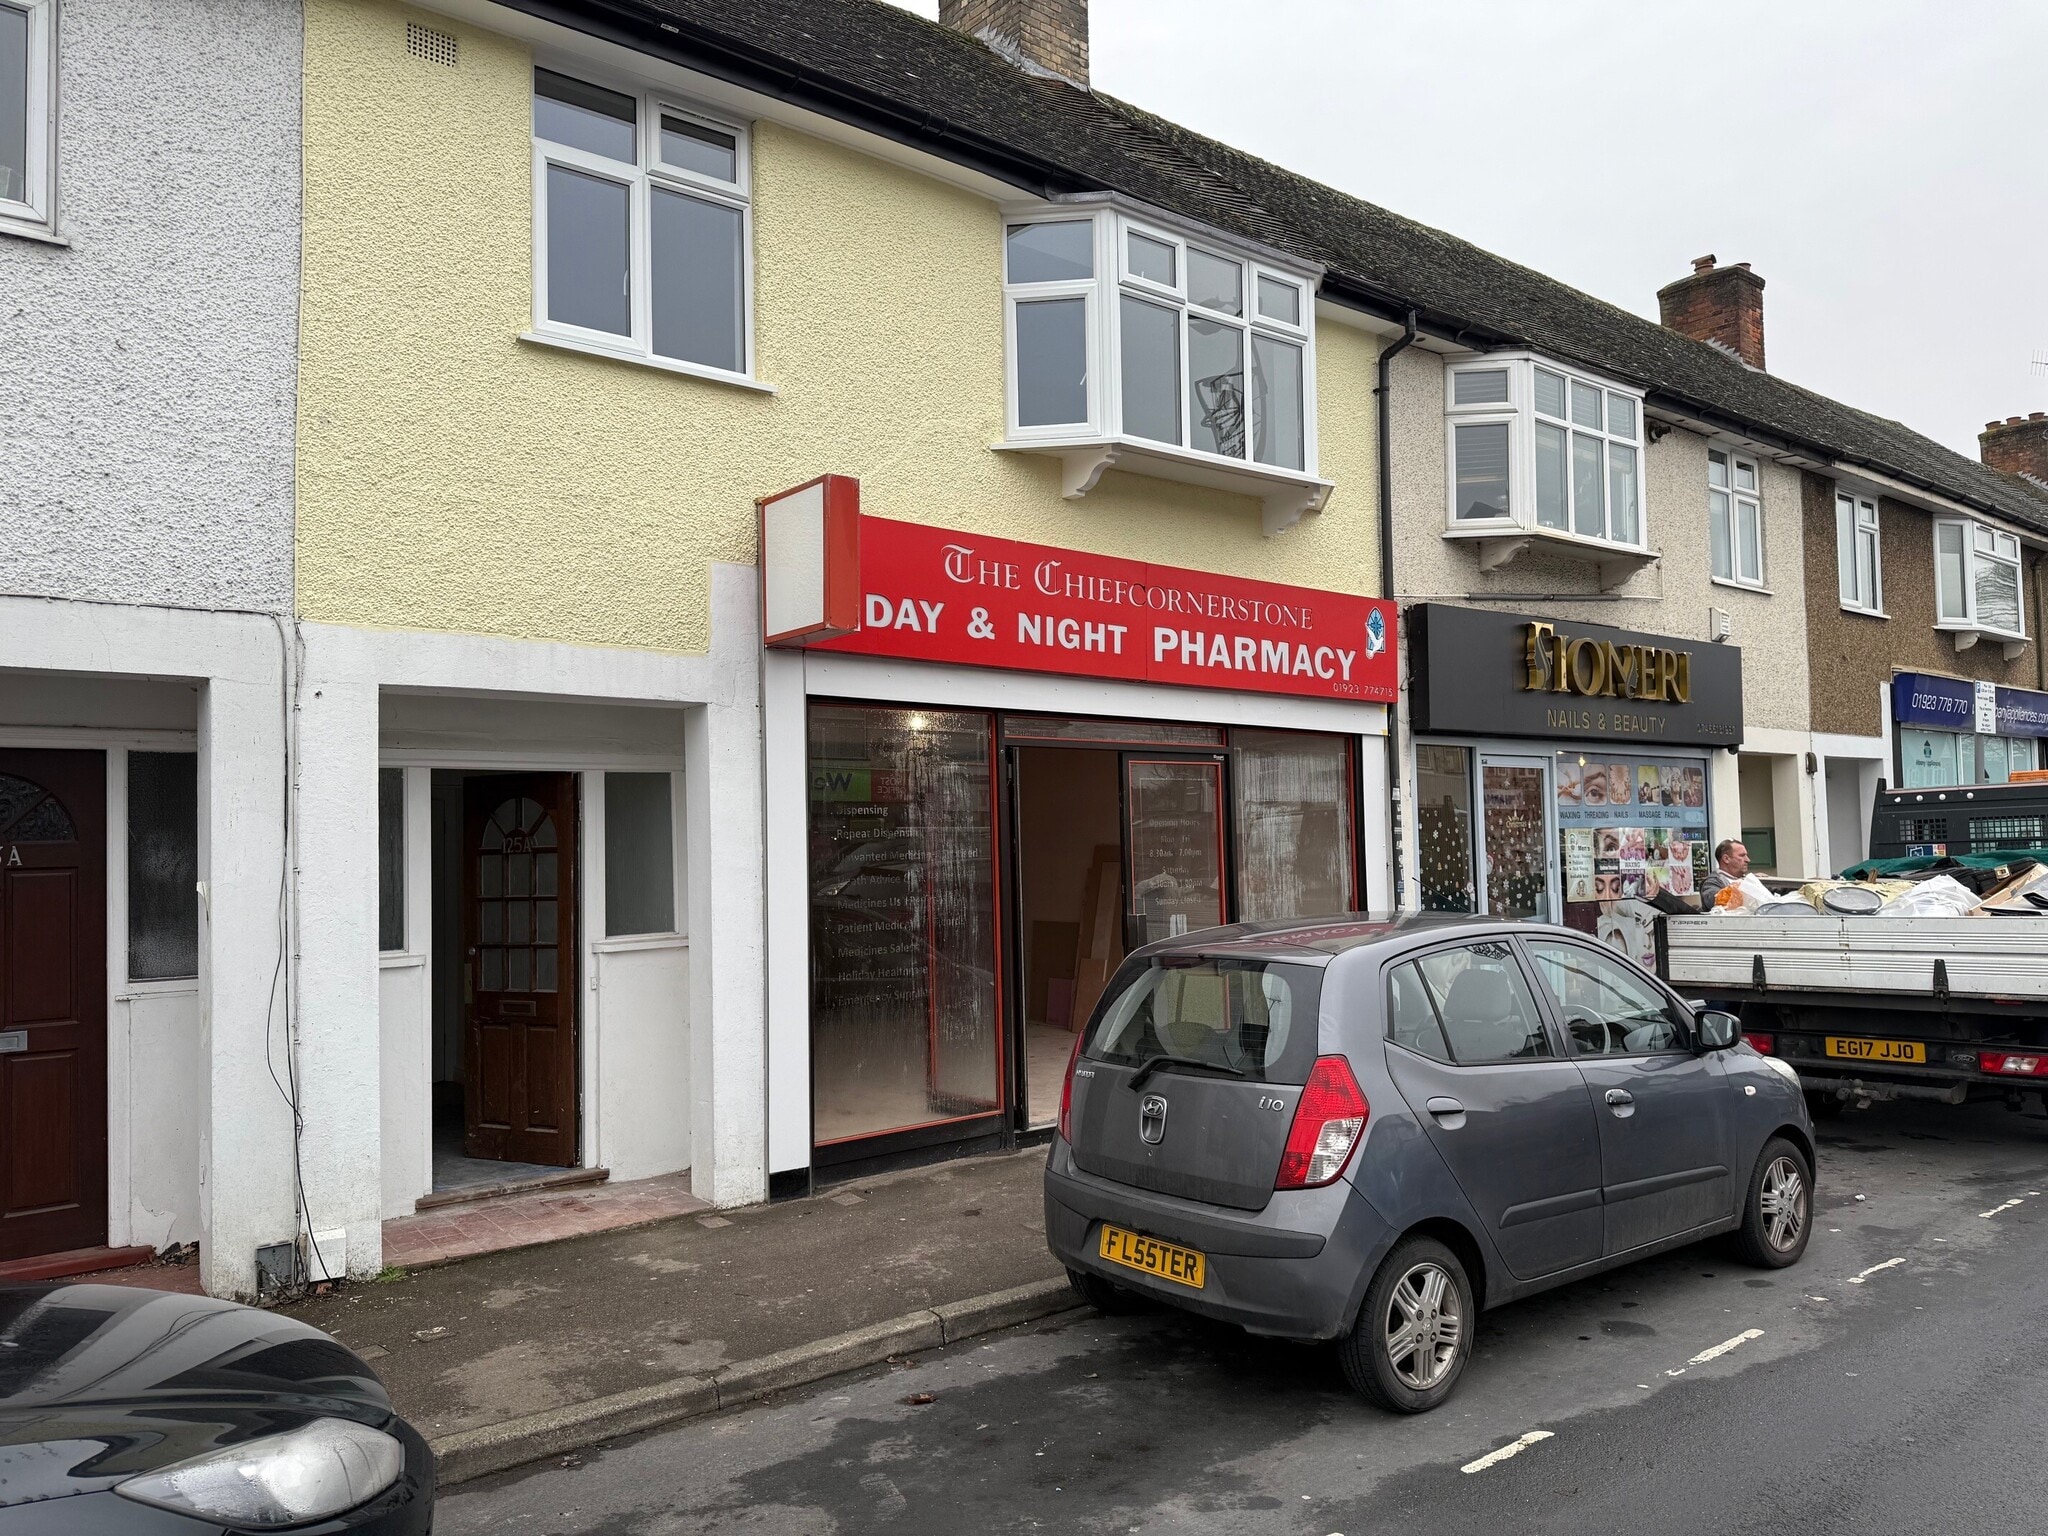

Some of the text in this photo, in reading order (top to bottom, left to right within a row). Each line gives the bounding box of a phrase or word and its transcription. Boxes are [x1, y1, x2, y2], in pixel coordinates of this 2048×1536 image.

[865, 593, 1357, 681] DAY & NIGHT PHARMACY
[1333, 682, 1393, 697] 01923 774715
[1911, 692, 1937, 710] 01923
[1937, 696, 1952, 713] 778
[1953, 698, 1968, 715] 770
[1547, 708, 1666, 735] NAILS & BEAUTY
[1560, 811, 1581, 819] WAXING
[1613, 811, 1629, 819] NAILS
[1664, 811, 1680, 819] FACIAL
[502, 837, 532, 854] 125A
[1836, 1040, 1914, 1059] EG17 JJO
[1258, 1095, 1285, 1112] i10
